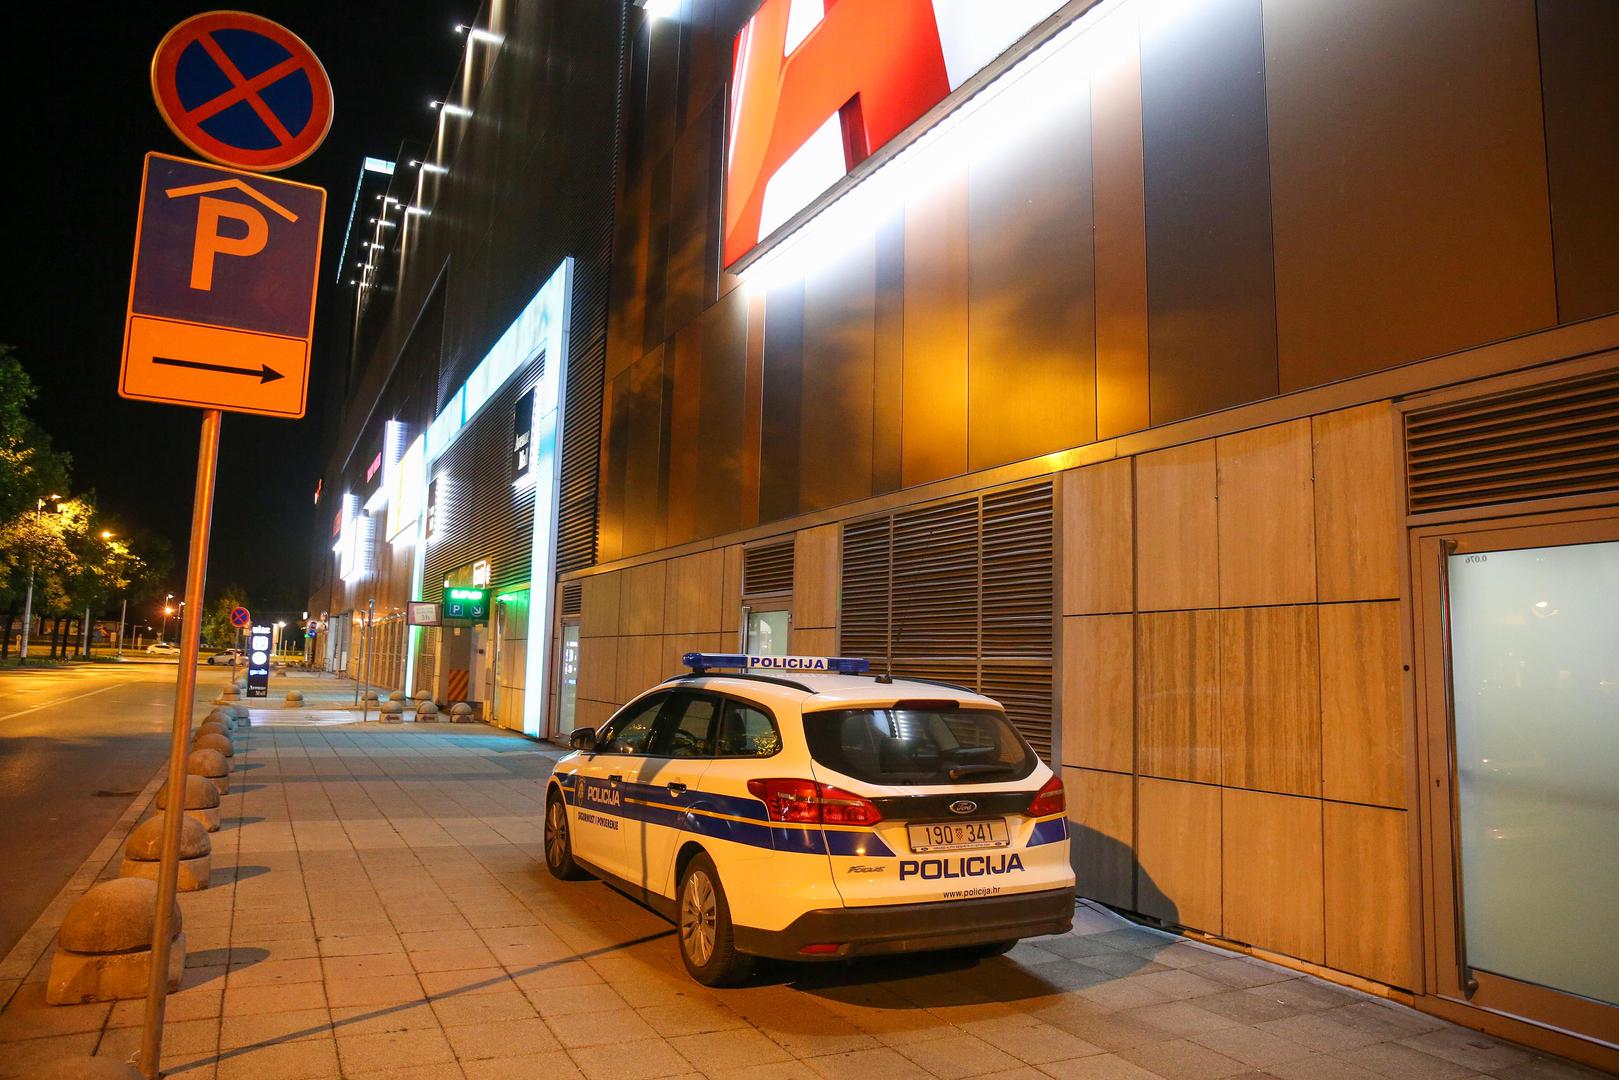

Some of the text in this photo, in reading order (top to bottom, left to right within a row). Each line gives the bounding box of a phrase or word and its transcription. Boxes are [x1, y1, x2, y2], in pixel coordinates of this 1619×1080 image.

[189, 195, 270, 292] P
[750, 656, 825, 669] POLICIJA
[587, 785, 621, 807] POLICIJA
[925, 823, 993, 845] 190 341
[847, 864, 886, 874] Focus
[899, 853, 1025, 881] POLICIJA
[943, 886, 1001, 899] www.policija.hr
